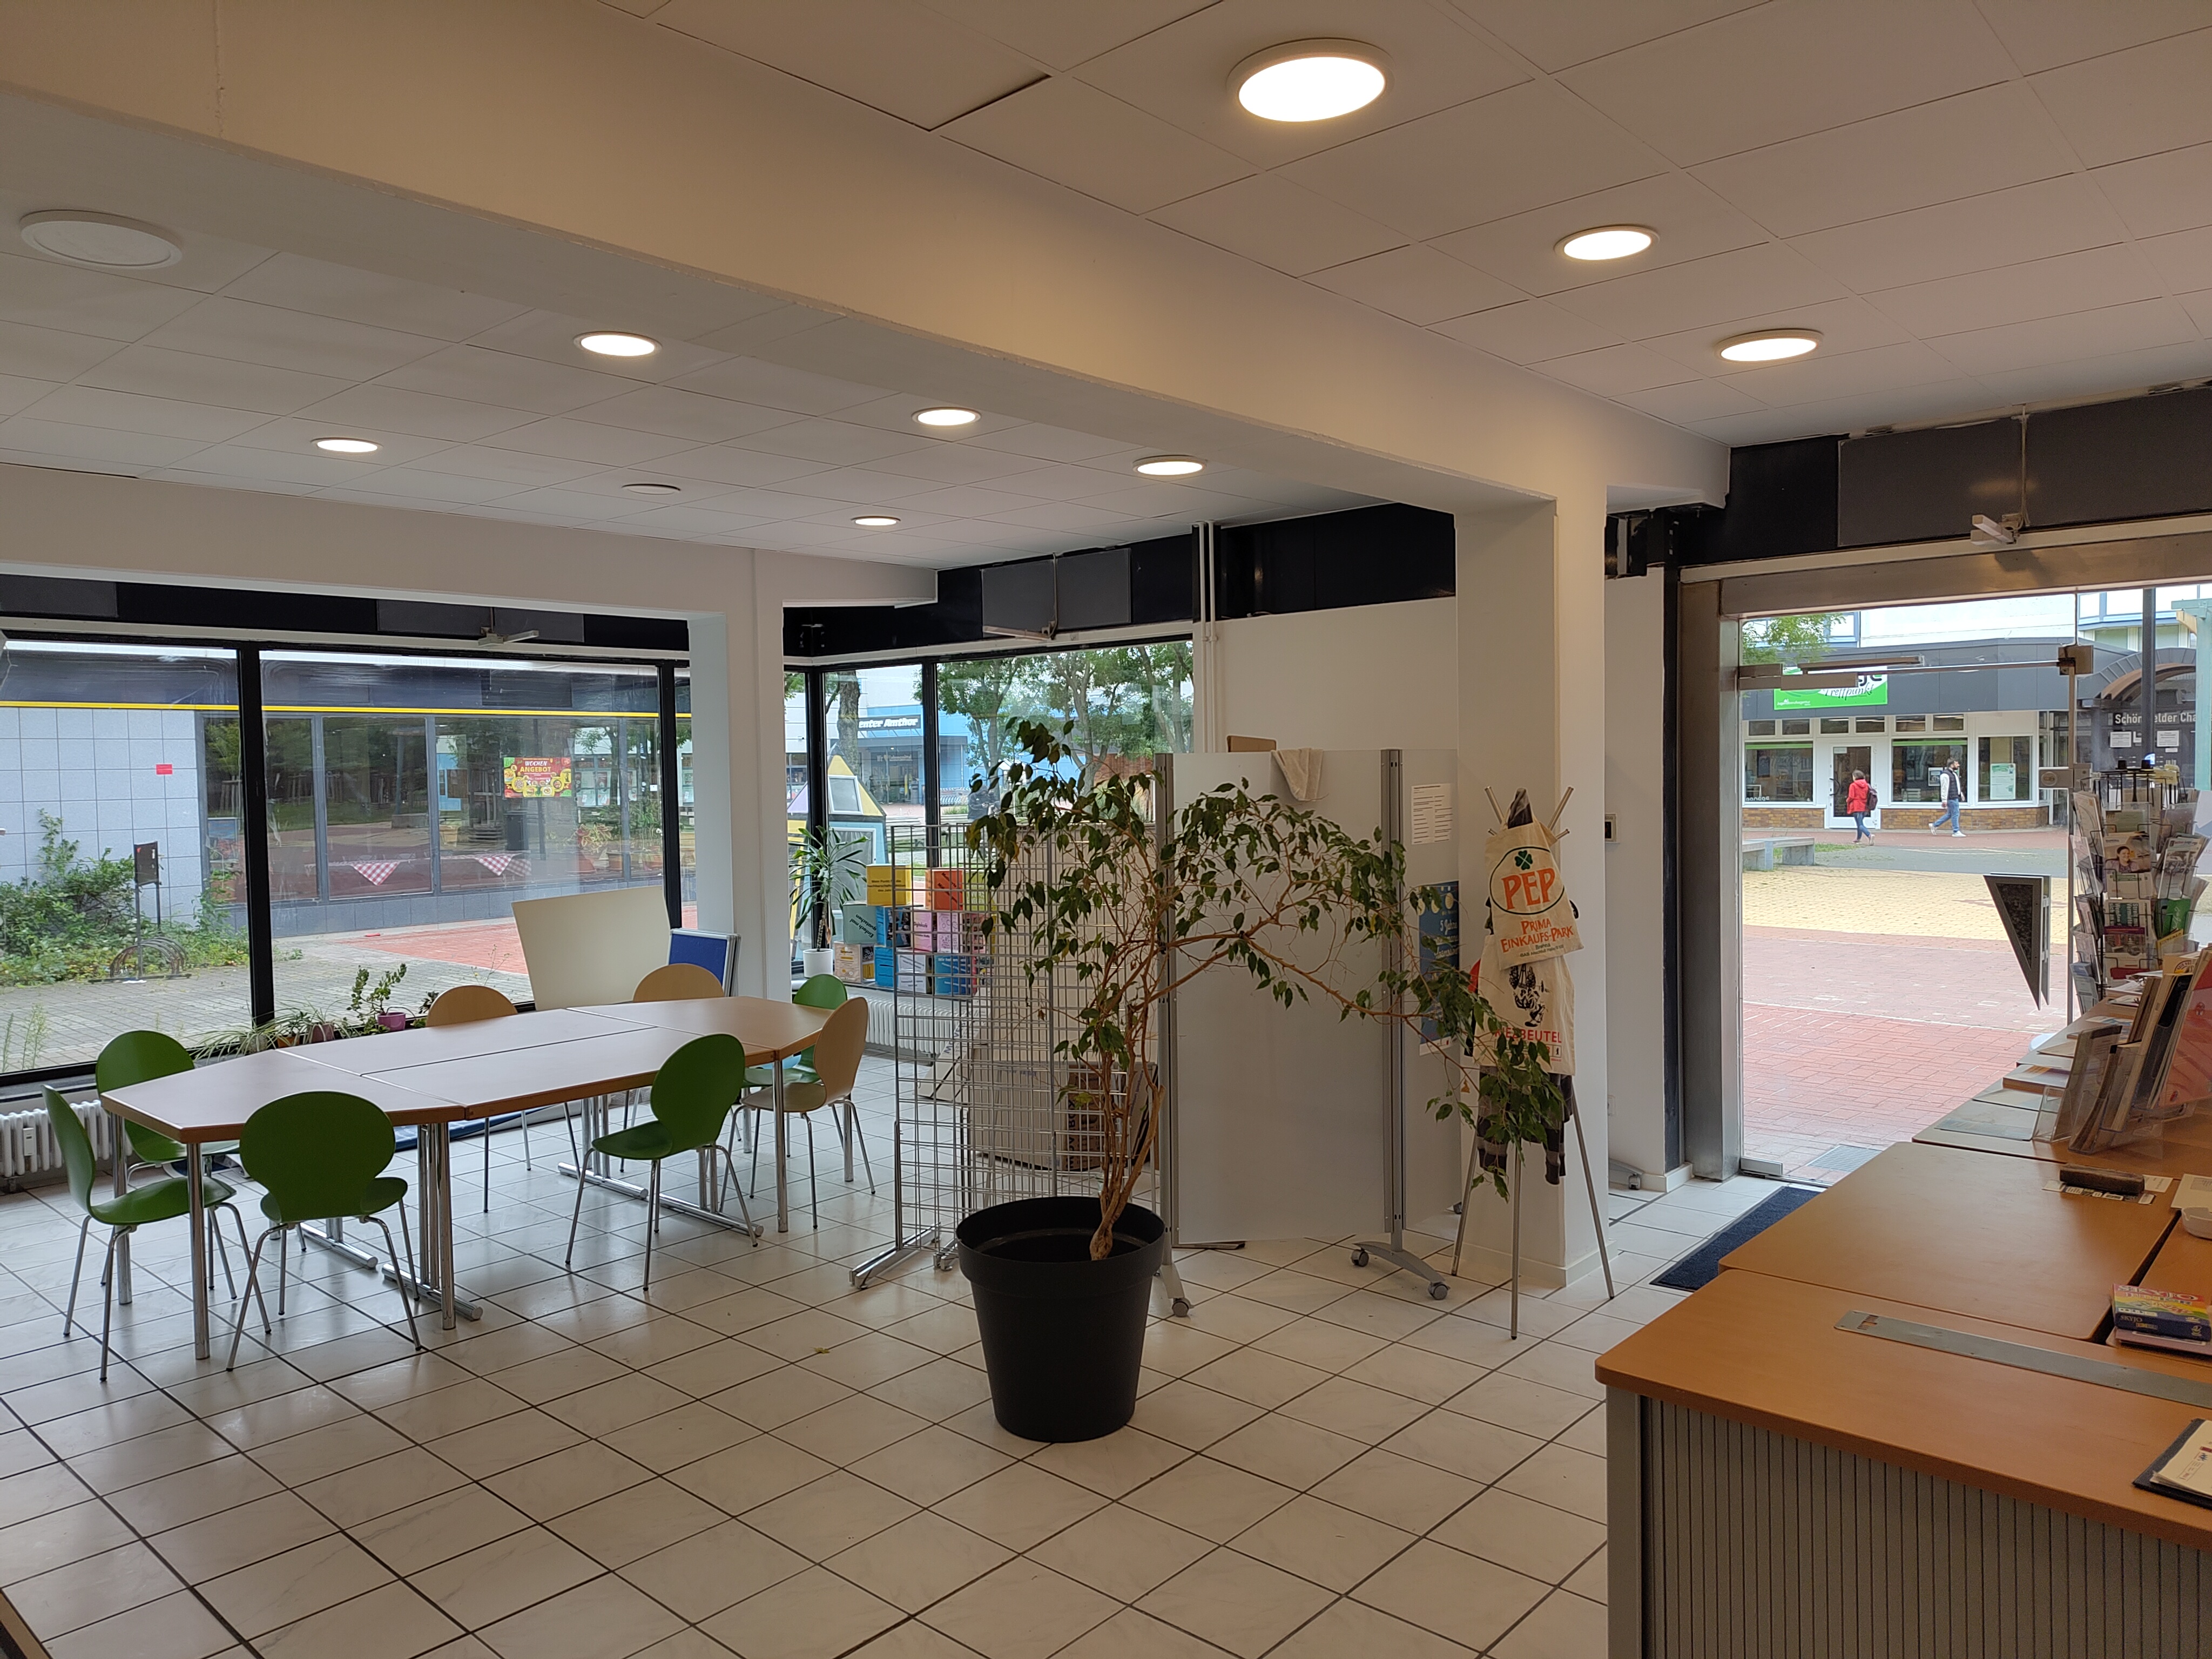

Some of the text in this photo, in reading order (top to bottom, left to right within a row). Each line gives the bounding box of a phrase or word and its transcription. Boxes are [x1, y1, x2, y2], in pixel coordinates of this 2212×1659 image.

[858, 718, 918, 728] enter Amthor
[2115, 713, 2177, 724] Schönelder
[1501, 868, 1555, 910] PEP
[855, 914, 877, 931] quatschen
[1440, 920, 1444, 932] 5
[1520, 918, 1552, 935] PRIMA
[859, 925, 874, 938] Einfach
[1500, 926, 1574, 953] EINKAUFS-PARK
[1066, 1100, 1076, 1169] MOVBOX
[2117, 1285, 2198, 1300] SKYJO
